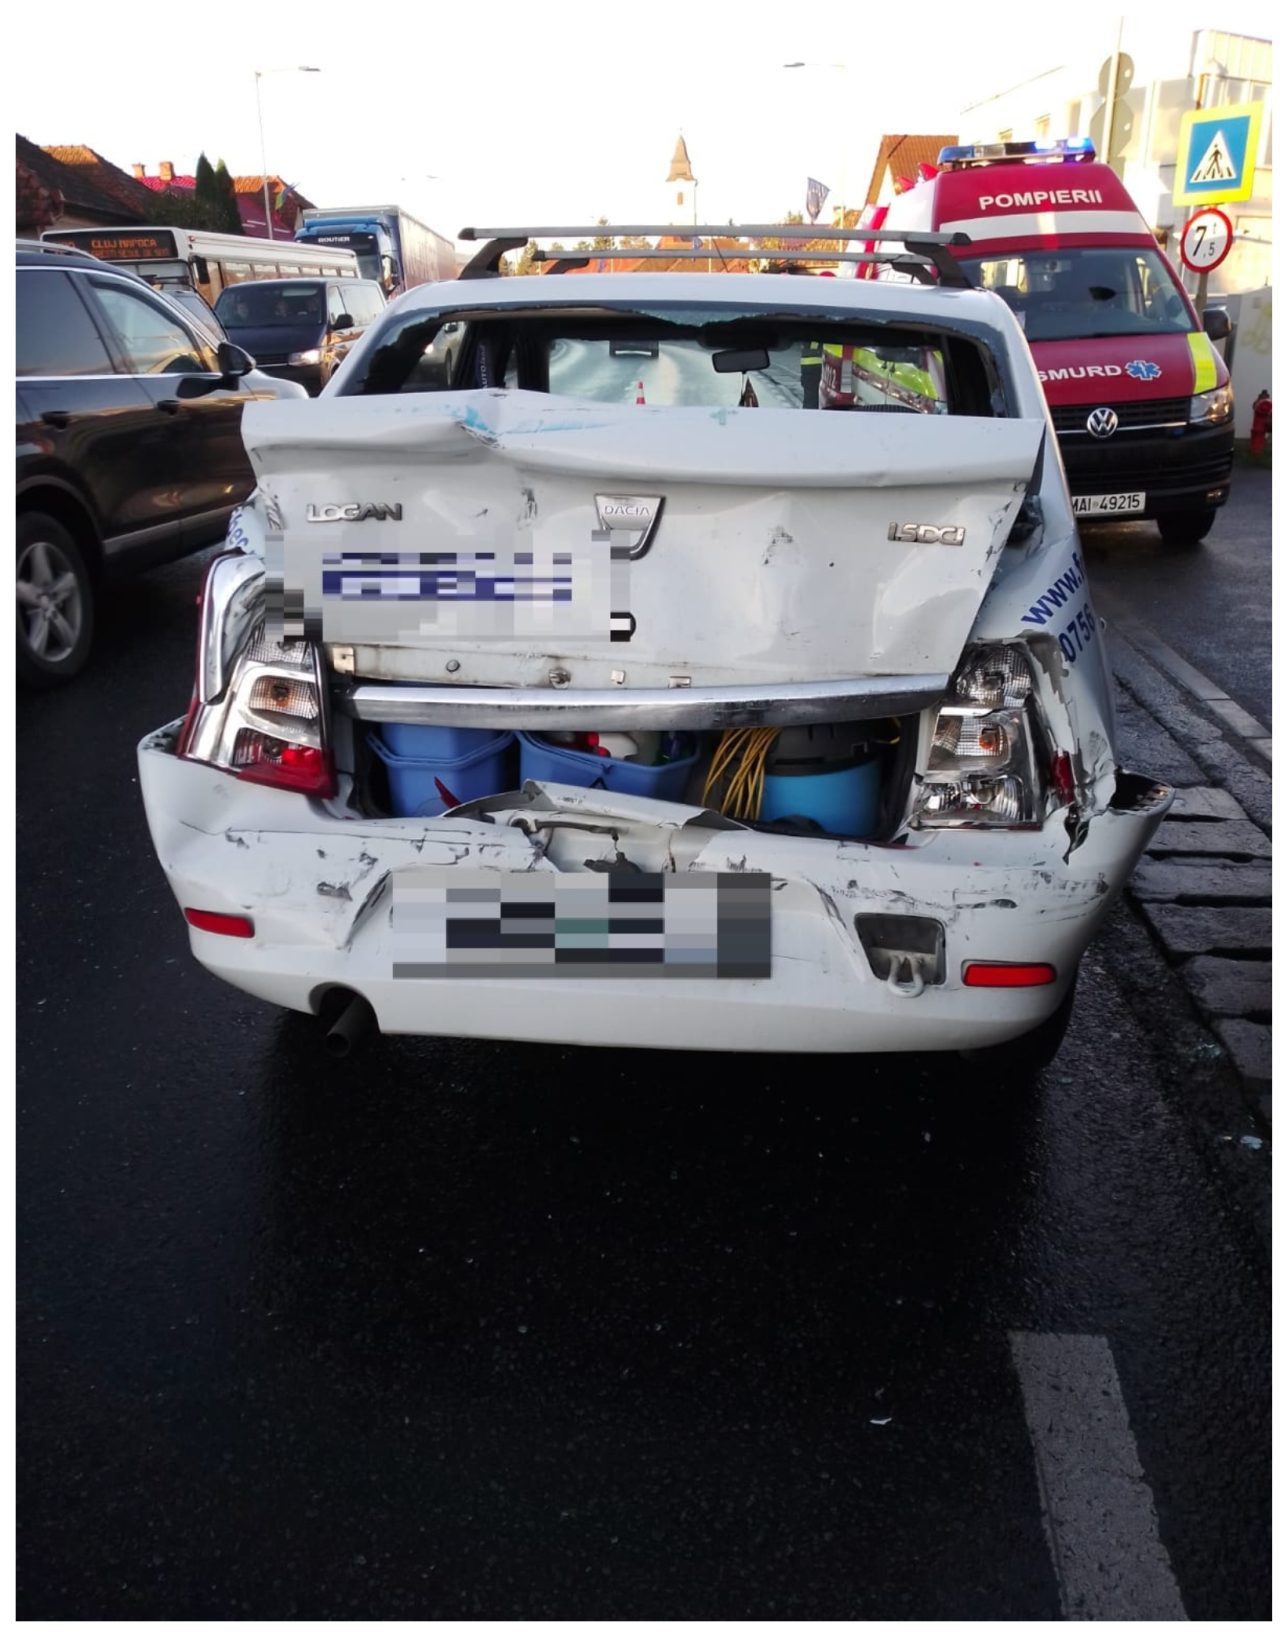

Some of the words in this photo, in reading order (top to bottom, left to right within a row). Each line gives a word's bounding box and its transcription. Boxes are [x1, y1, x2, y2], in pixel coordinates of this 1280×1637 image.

[978, 189, 1103, 211] POMPIERII
[91, 239, 118, 249] CLUJ
[1037, 365, 1122, 381] SMURD
[1100, 494, 1141, 510] 49215
[306, 503, 403, 523] LOGAN
[604, 505, 651, 516] DACIA
